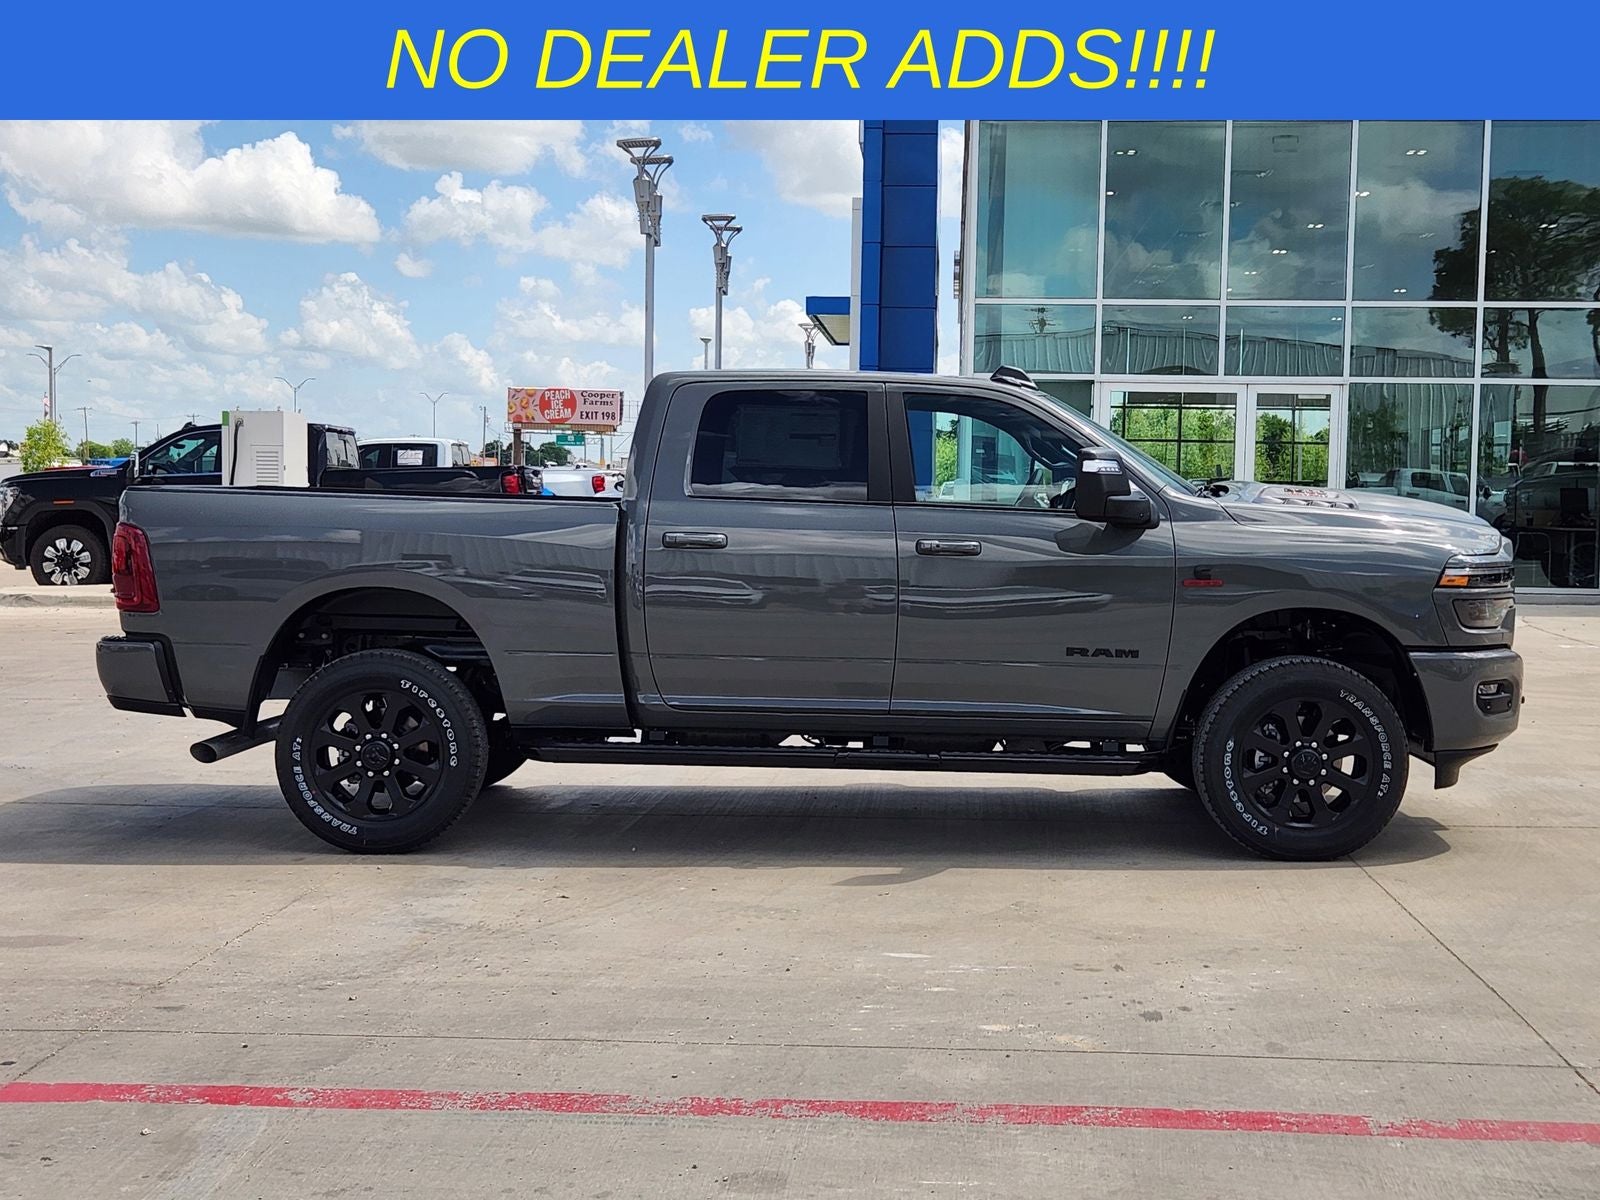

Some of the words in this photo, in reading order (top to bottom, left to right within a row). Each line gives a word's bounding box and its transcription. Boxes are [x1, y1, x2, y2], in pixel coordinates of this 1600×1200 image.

[544, 389, 571, 400] PEACH
[580, 390, 617, 399] Cooper
[551, 400, 564, 409] ICE
[583, 398, 614, 407] Farms
[544, 408, 572, 420] CREAM
[580, 411, 599, 420] EXIT
[601, 411, 616, 421] 198
[1065, 647, 1140, 659] RAM
[1339, 688, 1393, 770] TRANSFORCE
[293, 766, 358, 835] TRANSFORCE
